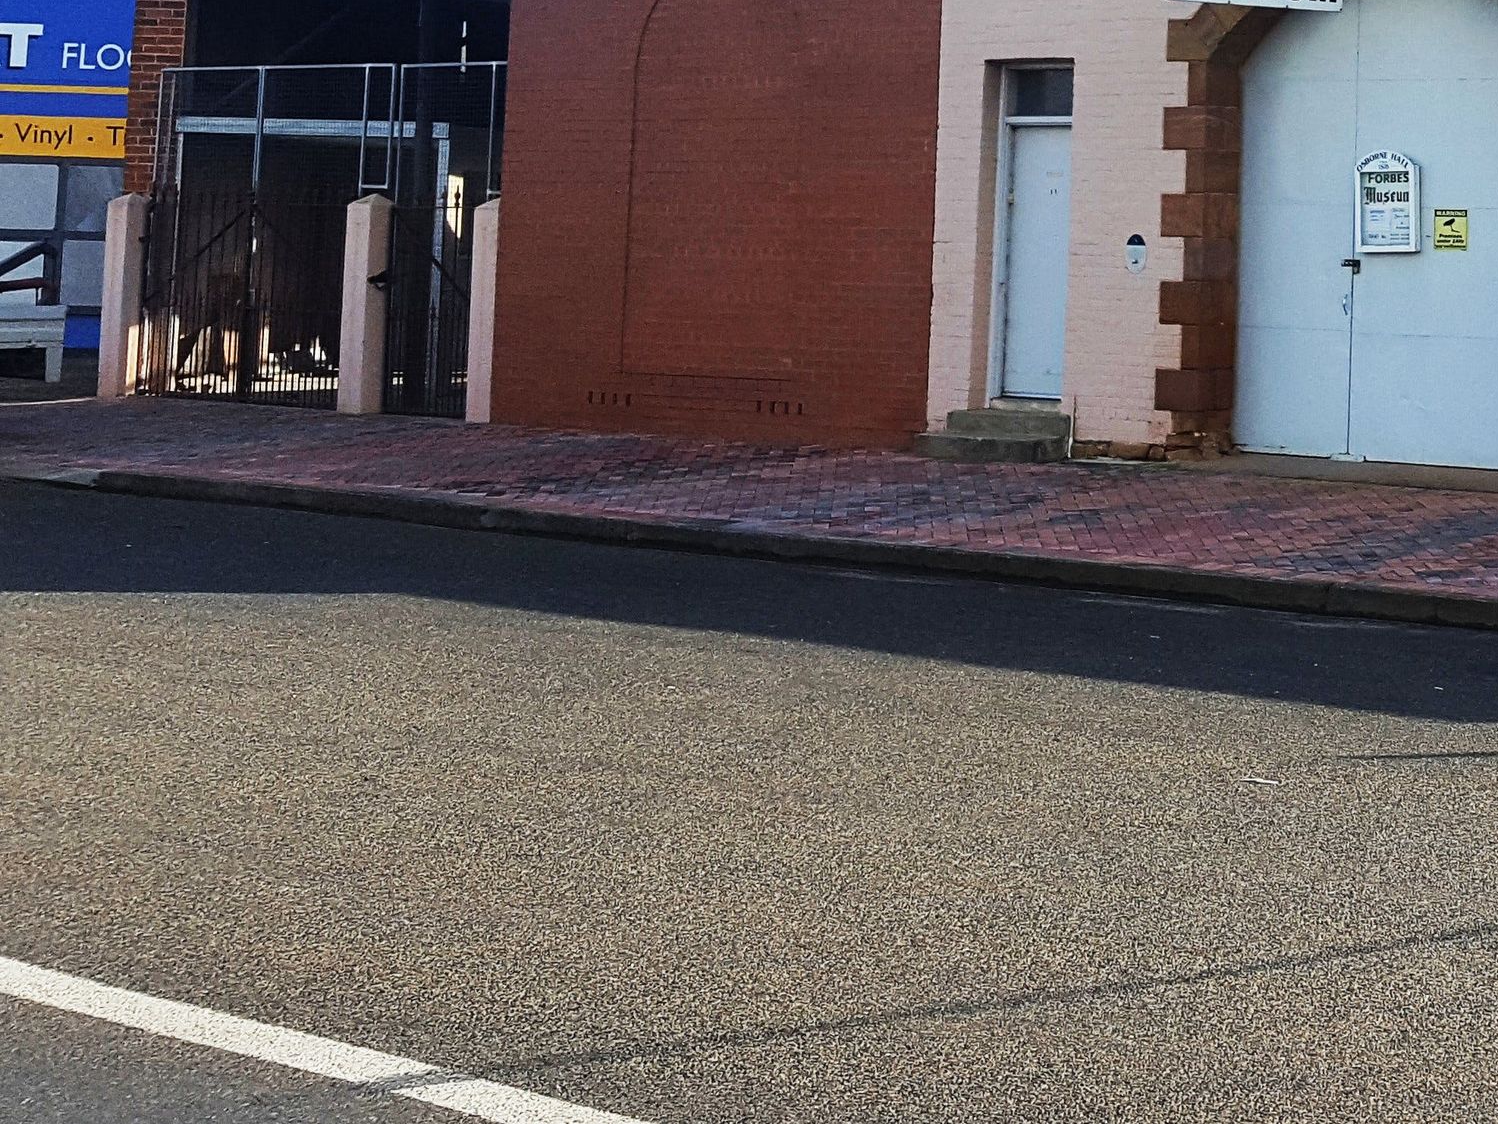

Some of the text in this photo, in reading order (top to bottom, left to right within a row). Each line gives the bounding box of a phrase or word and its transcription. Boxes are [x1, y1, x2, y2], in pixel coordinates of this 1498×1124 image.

[0, 22, 132, 70] T FLO
[15, 122, 127, 150] Vinyl T
[1368, 173, 1410, 184] FORBES
